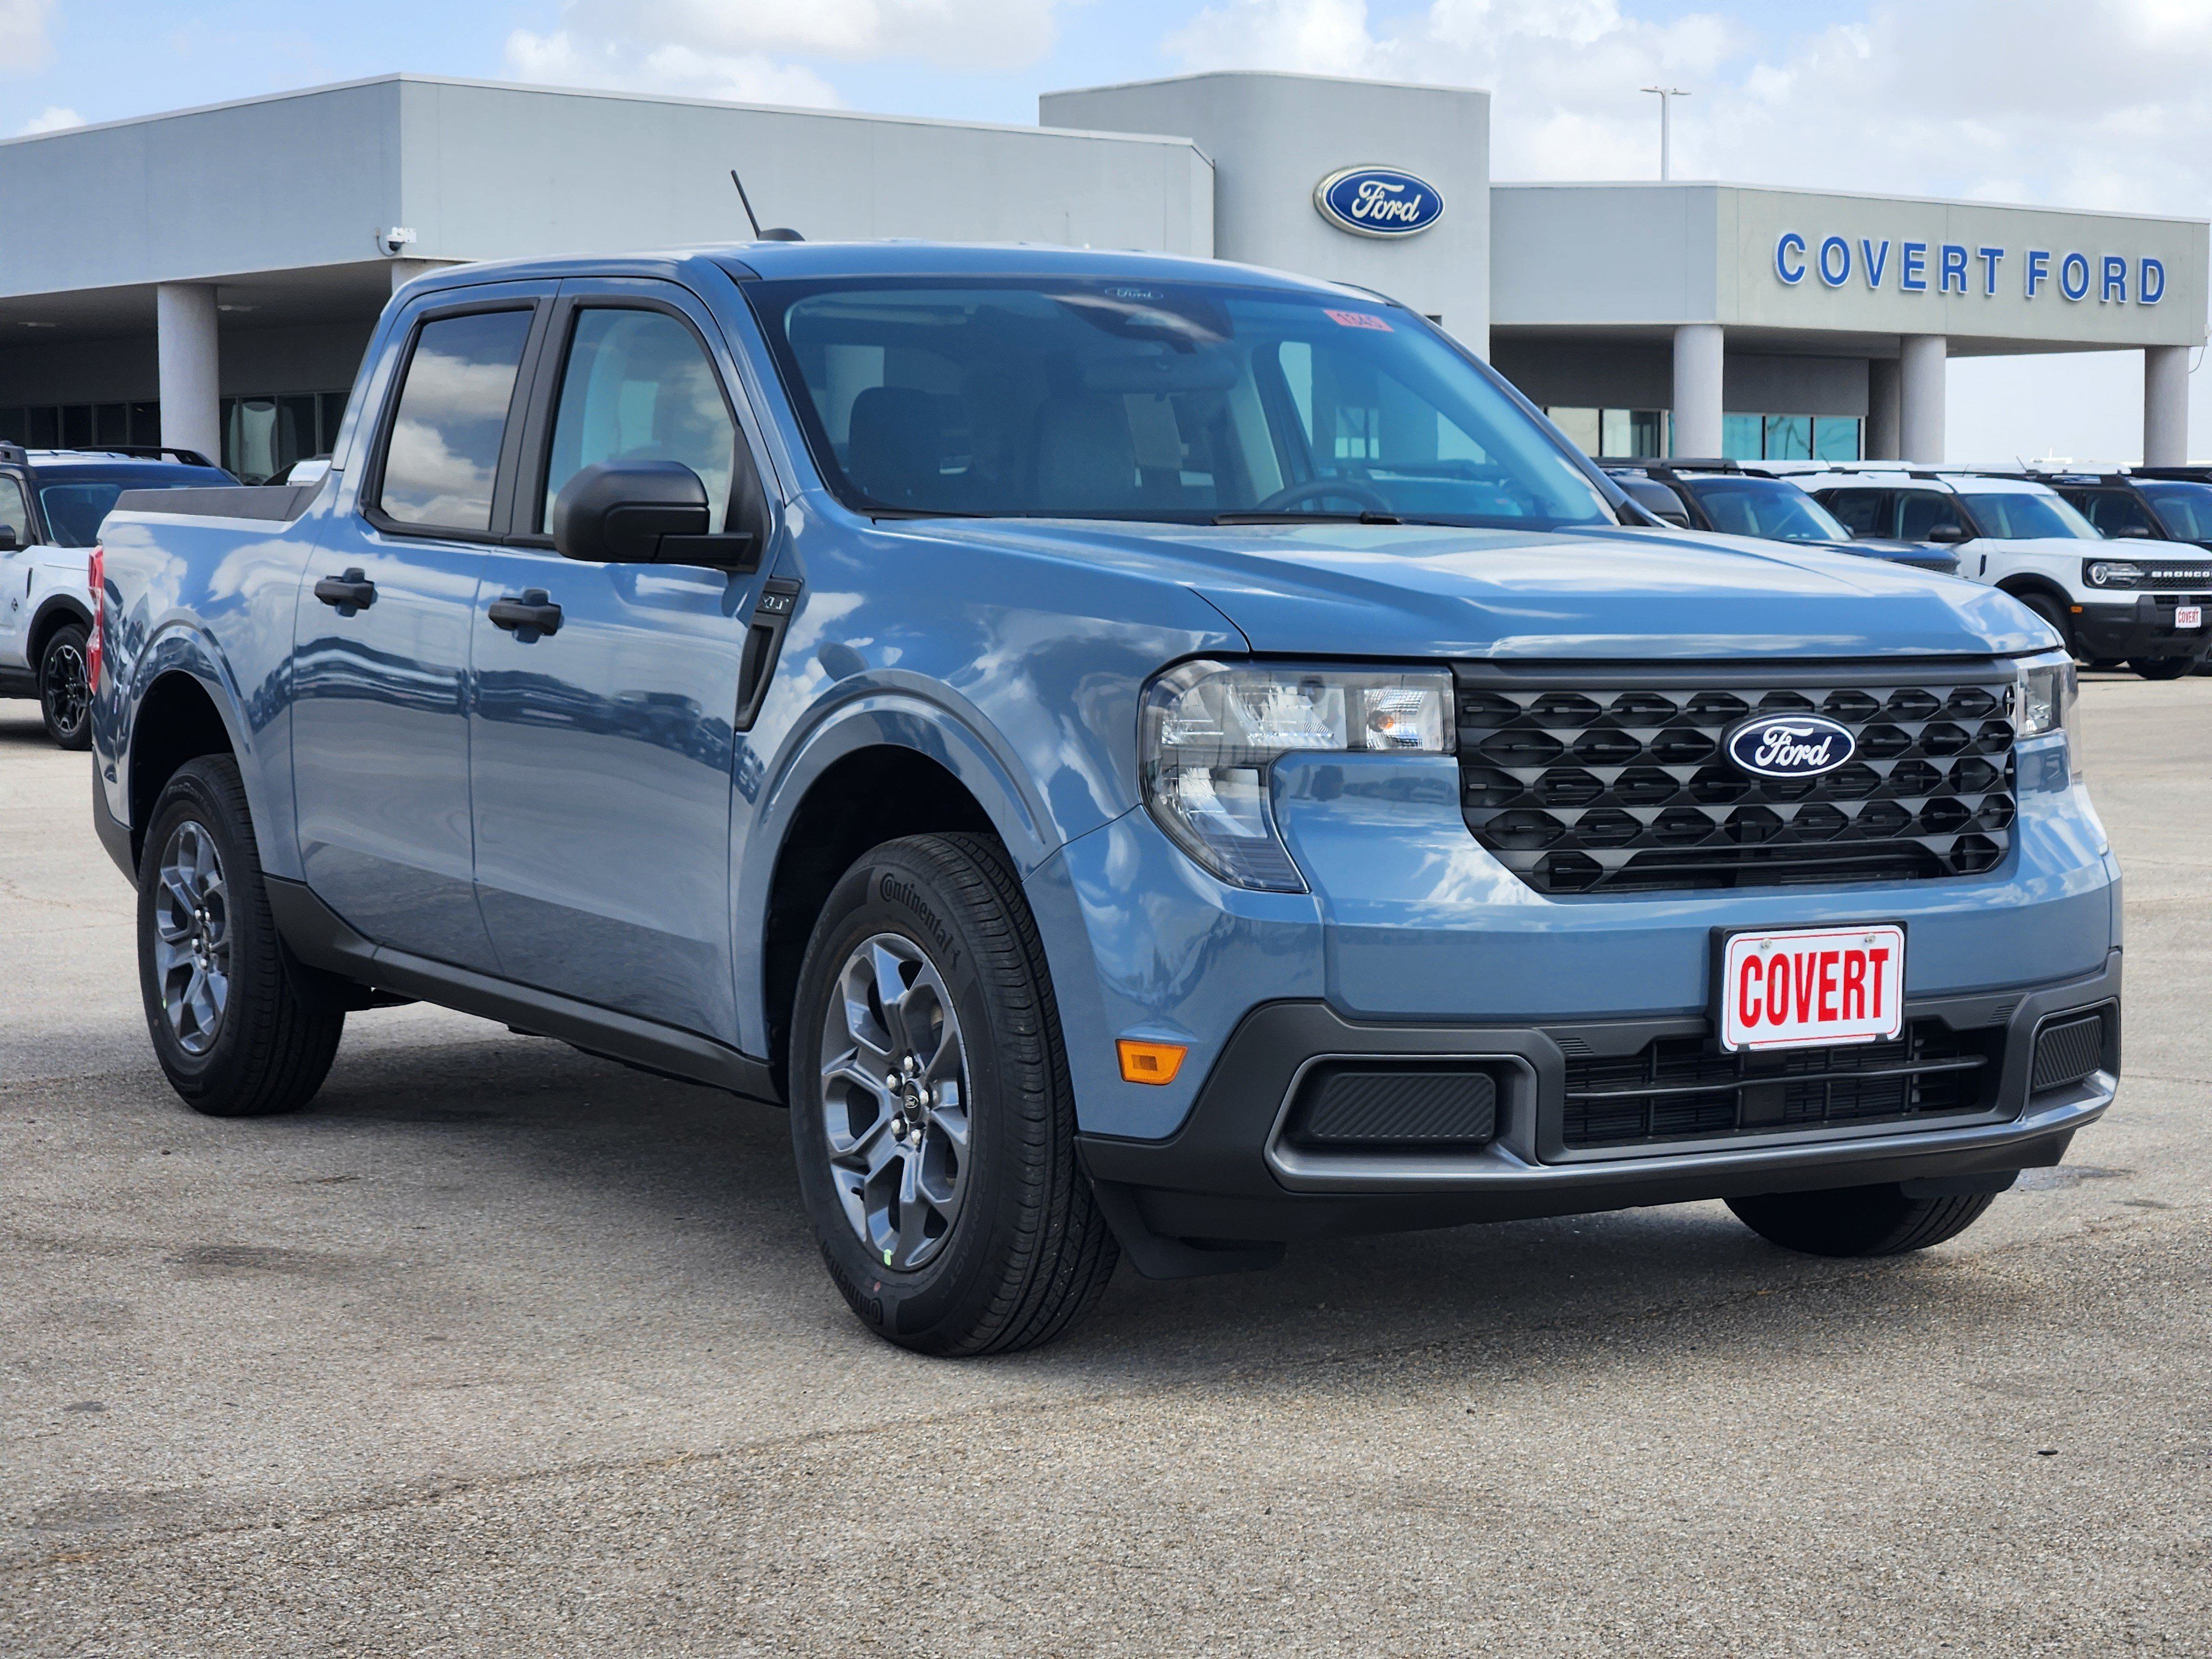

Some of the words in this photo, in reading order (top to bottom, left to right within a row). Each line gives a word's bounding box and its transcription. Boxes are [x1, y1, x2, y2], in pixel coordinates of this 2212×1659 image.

[1352, 180, 1422, 222] Ford
[1774, 232, 2005, 296] COVERT
[2025, 251, 2166, 305] FORD
[2178, 611, 2199, 623] COVERT
[1755, 726, 1833, 766] Ford
[879, 873, 954, 954] Continental
[1739, 948, 1890, 1029] COVERT
